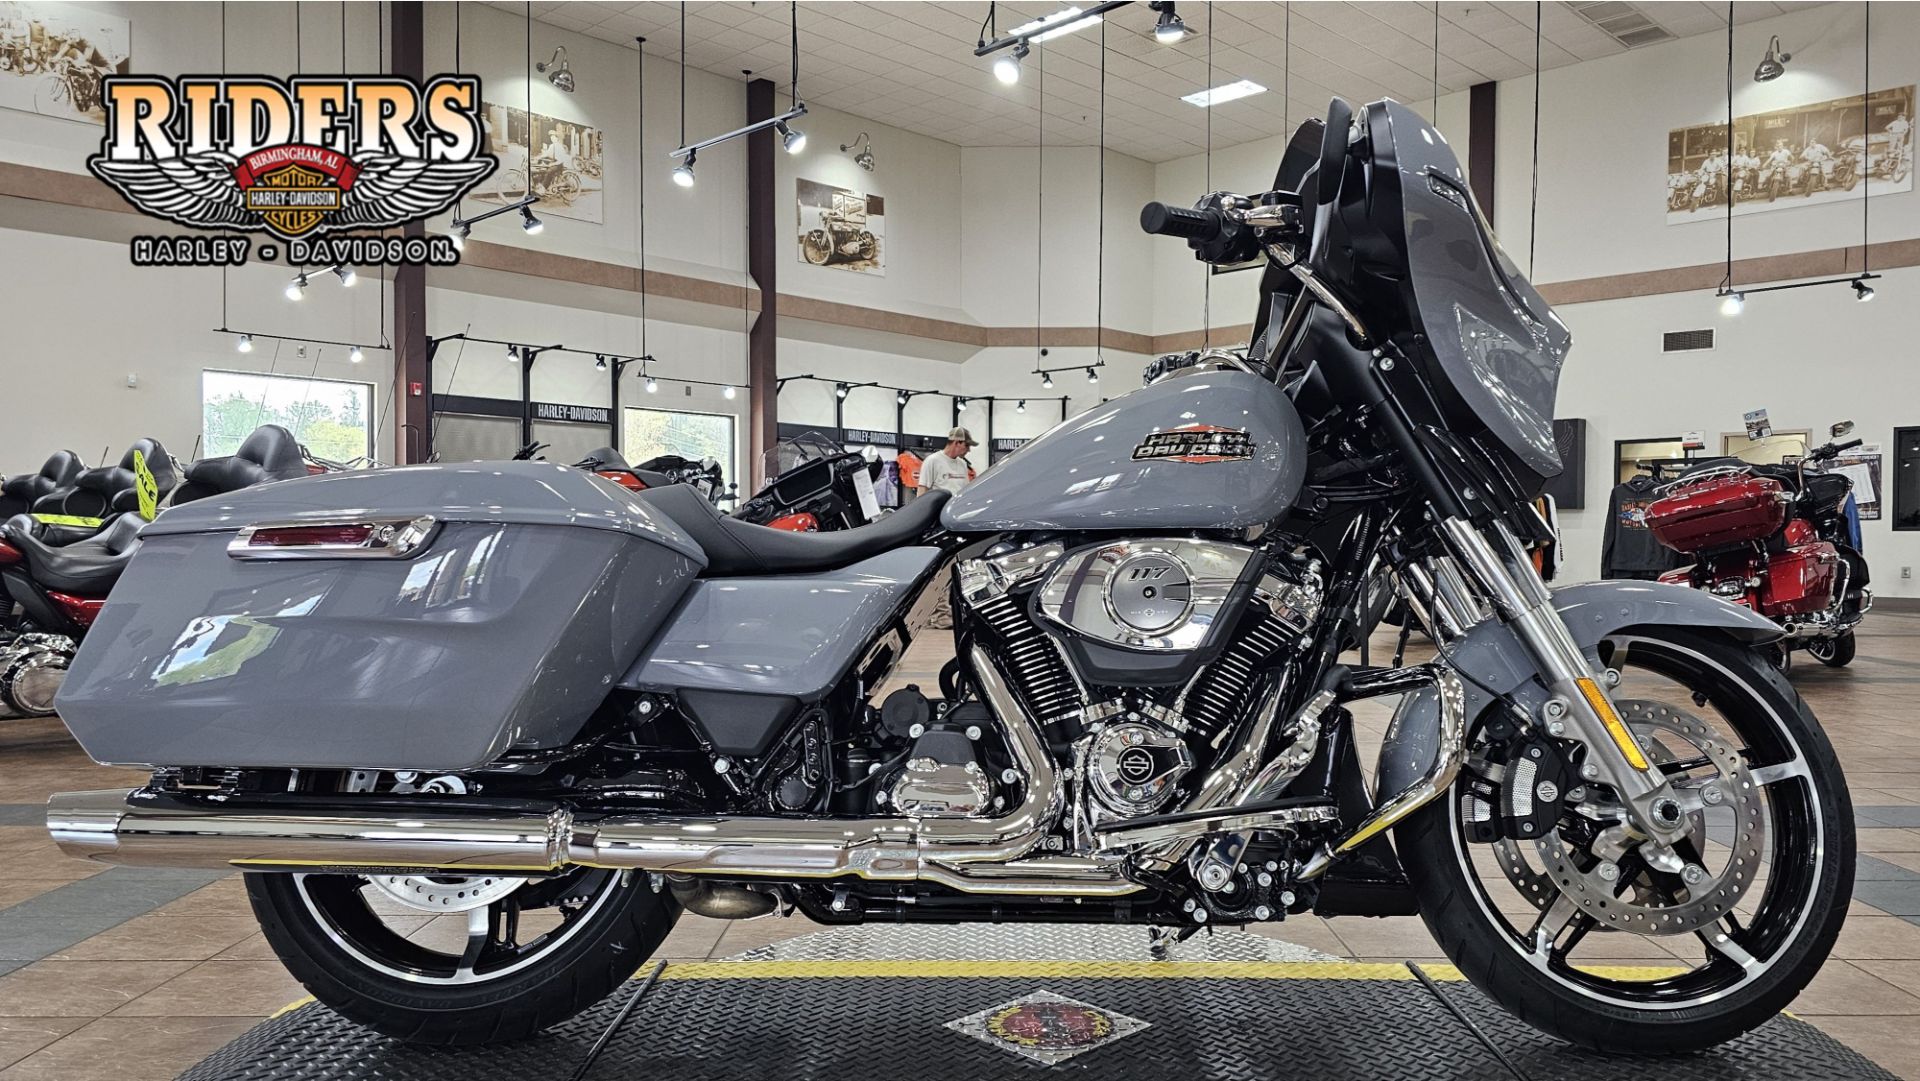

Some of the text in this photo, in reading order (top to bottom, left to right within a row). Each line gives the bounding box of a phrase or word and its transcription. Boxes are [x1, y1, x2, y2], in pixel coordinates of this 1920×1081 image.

[538, 404, 608, 421] HARLEY-DAVIDSON
[848, 430, 896, 445] HARLEY-DAVIDSON
[1128, 566, 1172, 581] 117
